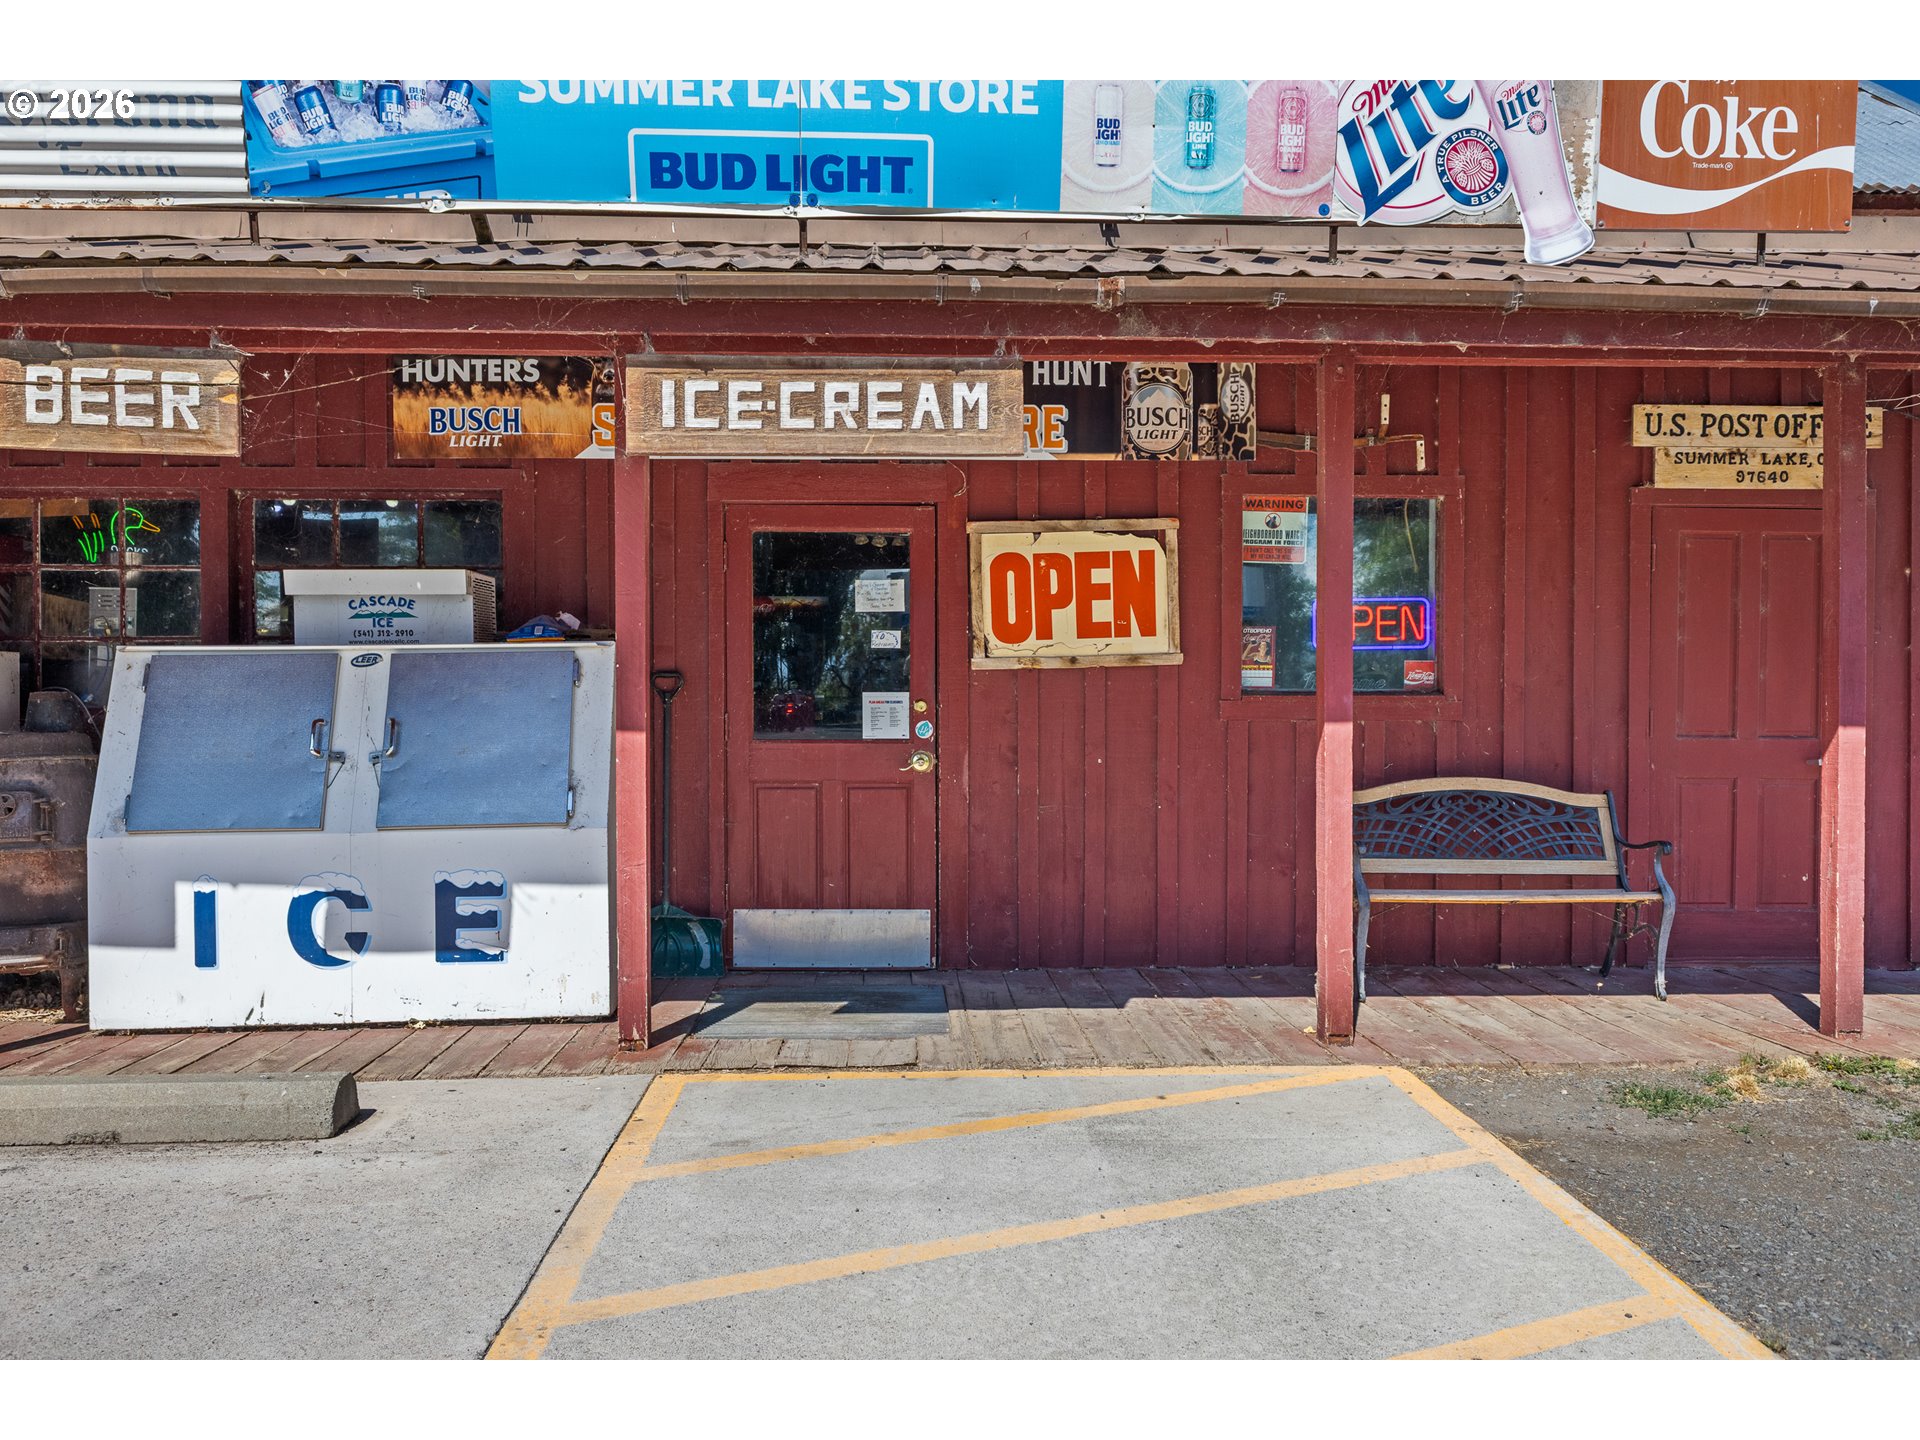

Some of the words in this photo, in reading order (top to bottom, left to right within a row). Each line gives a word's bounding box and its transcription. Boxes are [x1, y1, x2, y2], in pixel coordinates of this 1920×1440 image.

[448, 90, 469, 107] BUD
[518, 80, 734, 107] SUMMER
[748, 80, 872, 110] LAKE
[883, 80, 1039, 115] STORE
[1496, 84, 1541, 131] Lite
[301, 105, 324, 120] BUD
[1096, 118, 1121, 129] BUD
[1640, 80, 1799, 161] Coke
[1185, 132, 1214, 143] LIGHT
[1188, 121, 1213, 132] BUD
[1280, 124, 1305, 136] BUD
[1337, 80, 1470, 221] Lite
[1451, 129, 1499, 152] PILSNER
[1437, 141, 1451, 173] TRUE
[649, 151, 757, 190] BUD
[766, 154, 914, 194] LIGHT
[1442, 175, 1450, 184] A
[1471, 182, 1505, 206] BEER
[401, 358, 541, 383] HUNTERS
[1032, 361, 1112, 387] HUNT
[25, 366, 201, 430] BEER
[1229, 373, 1240, 423] BUSCH
[429, 406, 522, 435] BUSCH
[1126, 406, 1189, 429] BUSCH
[1645, 412, 1692, 437] U.S.
[1700, 413, 1768, 439] POST
[1136, 429, 1179, 440] LIGHT
[1674, 451, 1749, 465] SUMMER
[1761, 452, 1813, 468] LAKE,
[1735, 470, 1789, 484] 97640
[1244, 499, 1304, 509] WARNING
[348, 595, 416, 610] CASCADE
[989, 549, 1157, 645] OPEN
[353, 629, 374, 638] (541)
[372, 617, 394, 628] ICE
[1351, 604, 1426, 642] PEN
[355, 656, 378, 664] LEER
